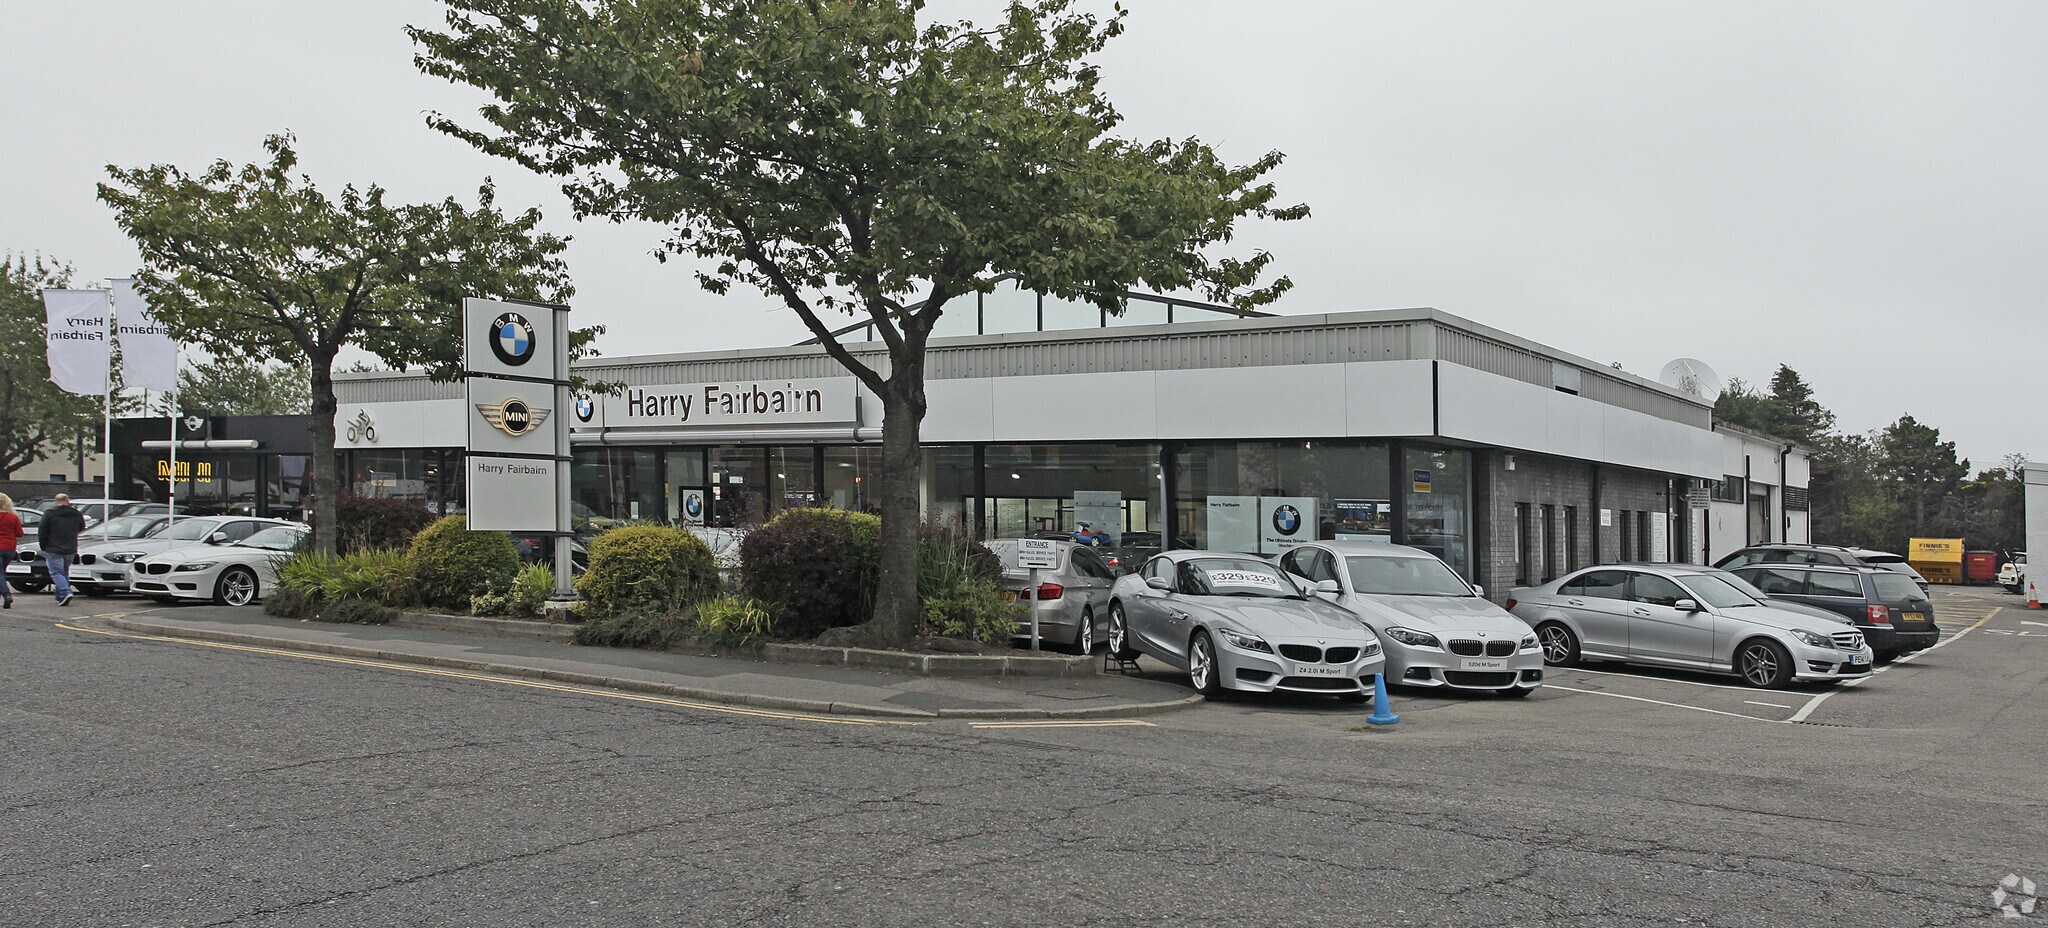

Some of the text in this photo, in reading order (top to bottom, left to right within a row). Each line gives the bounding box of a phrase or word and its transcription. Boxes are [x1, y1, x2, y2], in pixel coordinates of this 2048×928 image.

[495, 313, 533, 333] BMW
[628, 383, 823, 422] Harry Fairbairn
[505, 411, 528, 423] MINI
[478, 463, 547, 475] Harry Fairbairn
[1212, 572, 1244, 581] £329
